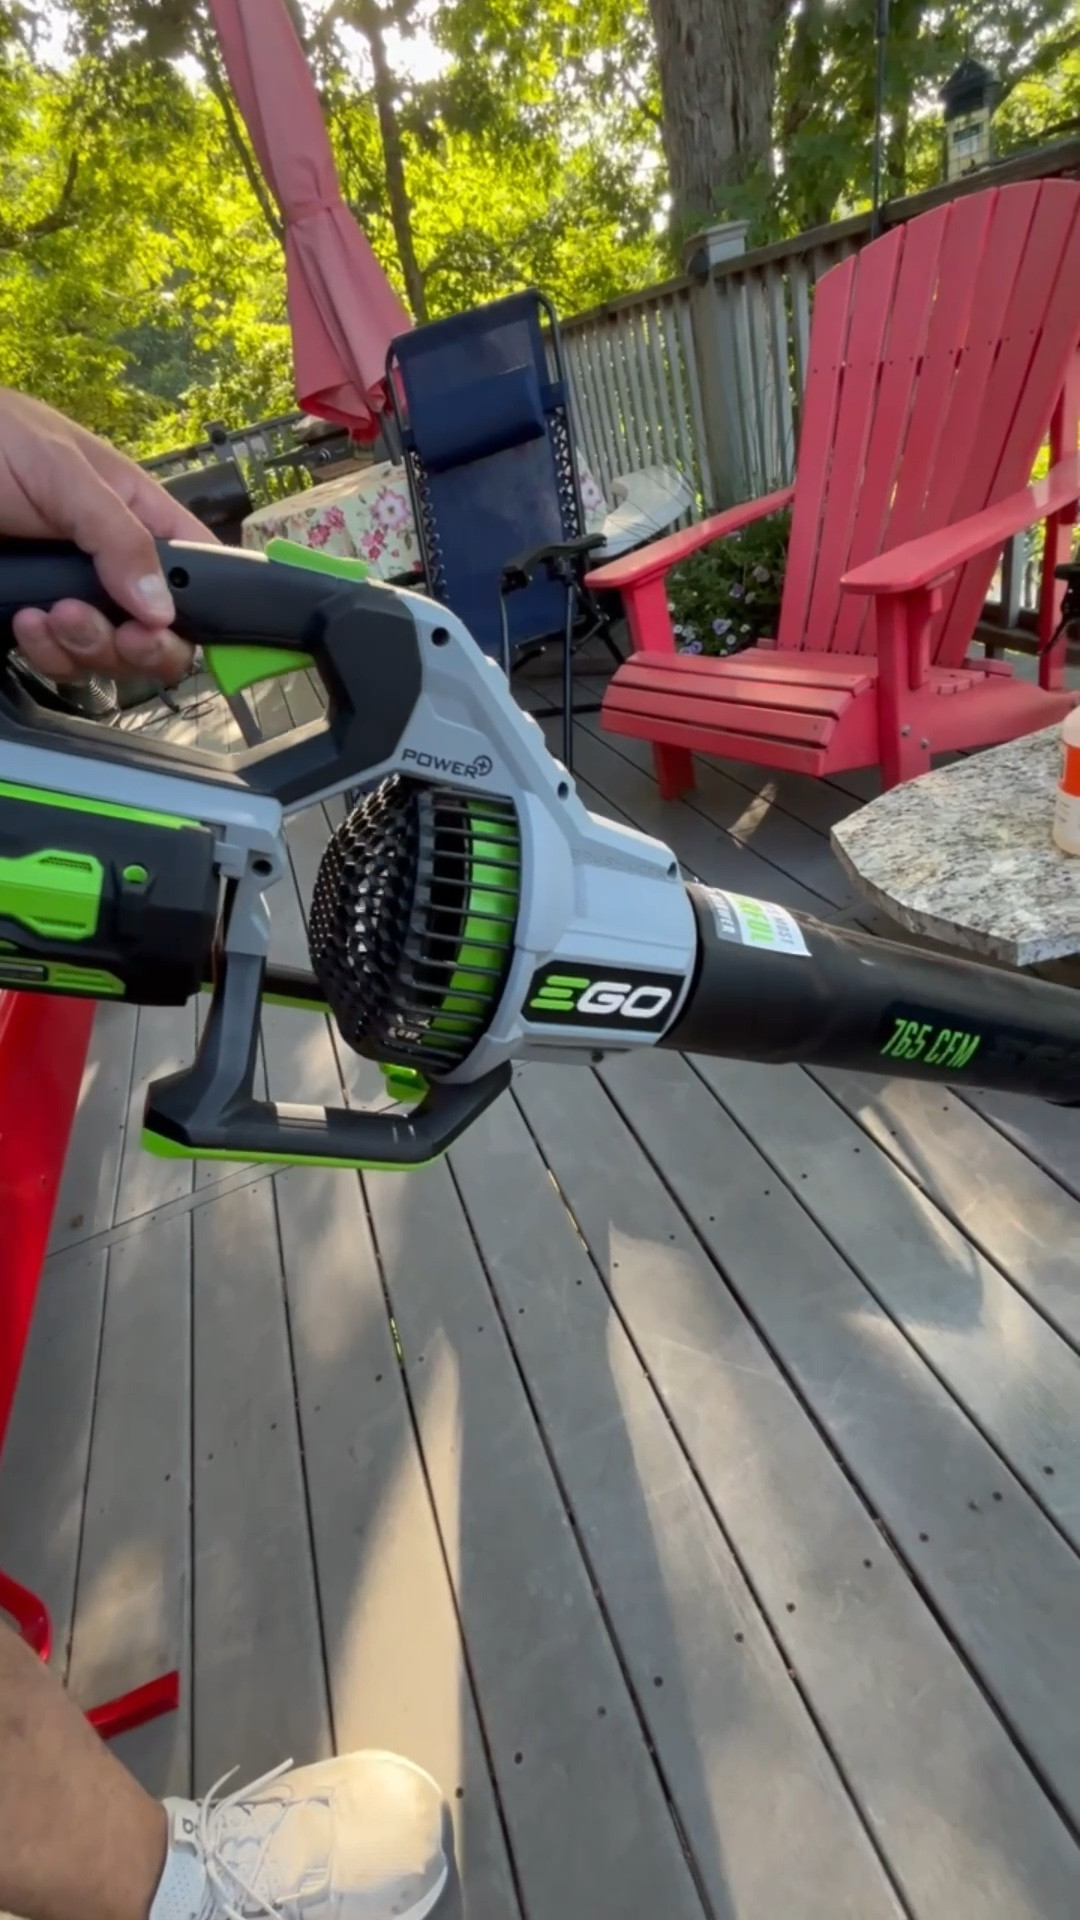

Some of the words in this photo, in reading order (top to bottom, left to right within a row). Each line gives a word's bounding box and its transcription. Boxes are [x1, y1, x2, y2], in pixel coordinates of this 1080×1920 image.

[529, 974, 673, 1019] EGO
[880, 1018, 933, 1060] 765
[923, 1028, 981, 1069] CFM
